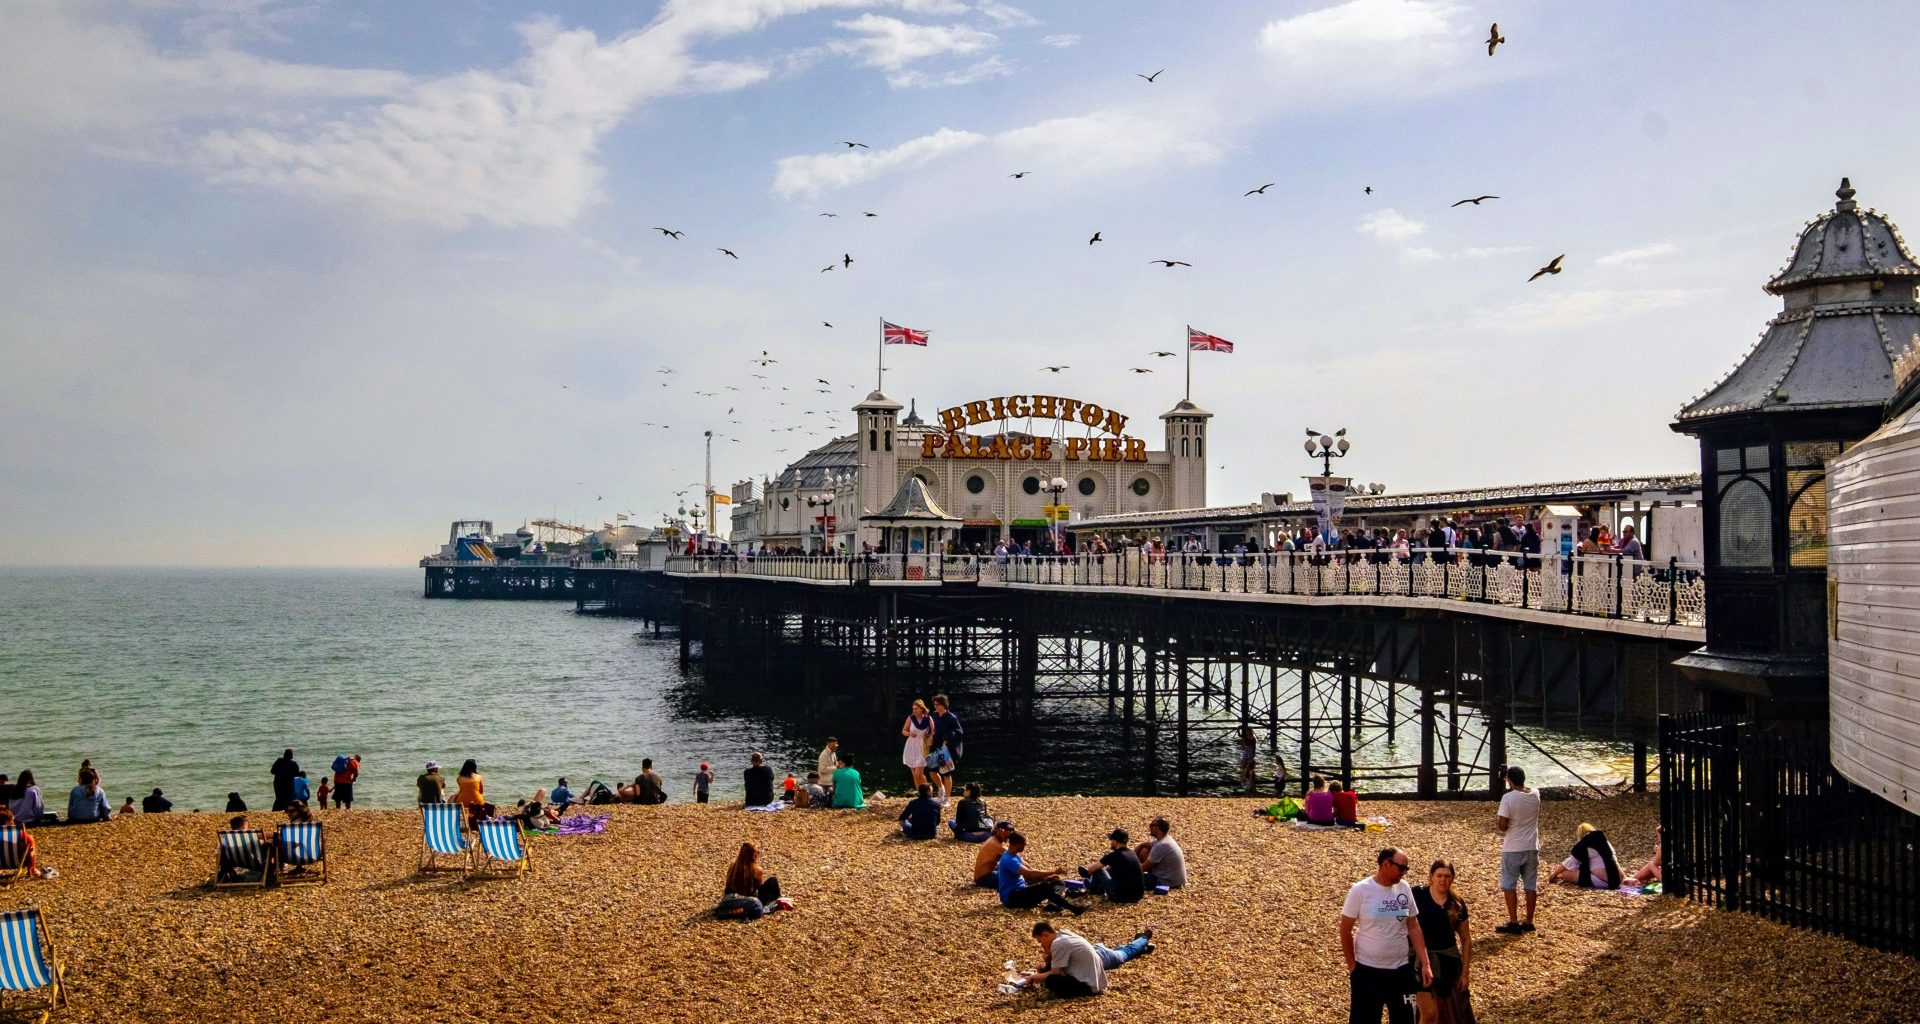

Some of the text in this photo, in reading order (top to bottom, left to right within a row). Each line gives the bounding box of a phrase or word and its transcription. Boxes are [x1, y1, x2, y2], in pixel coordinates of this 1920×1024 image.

[938, 395, 1129, 437] BRIGHTON
[921, 432, 1148, 463] PALACE PIER
